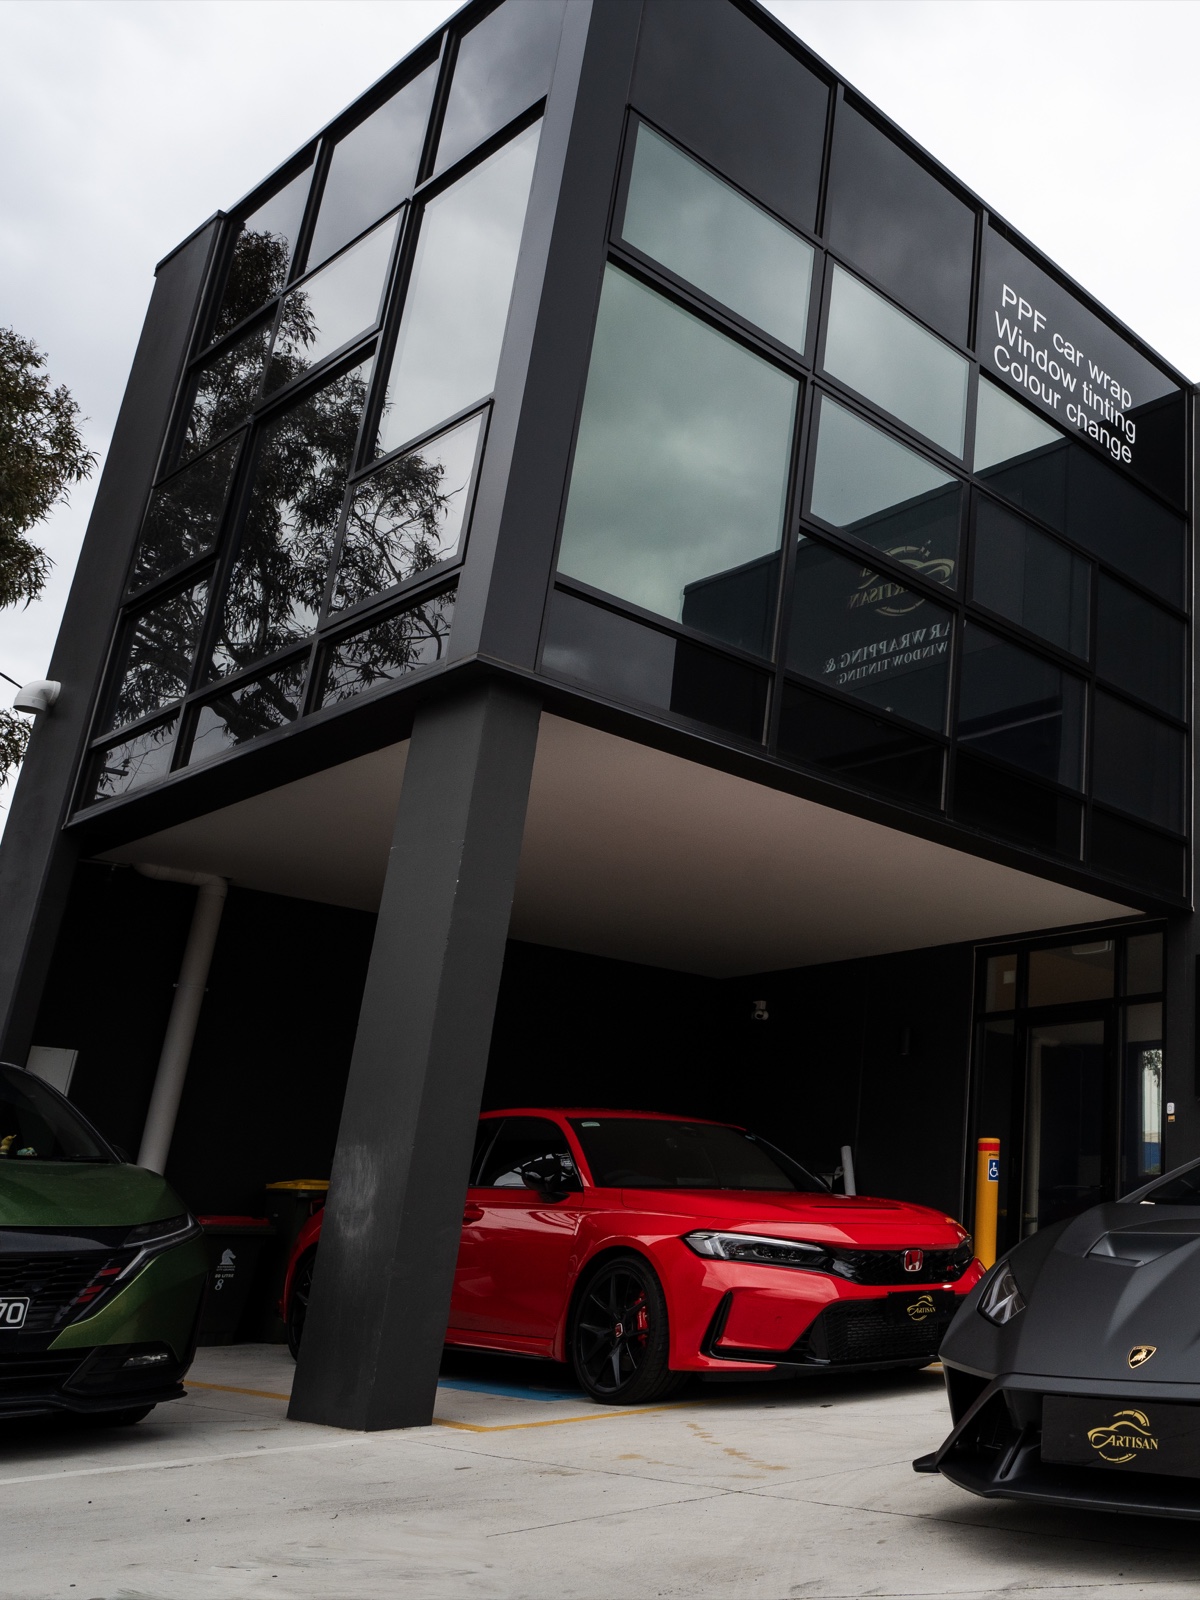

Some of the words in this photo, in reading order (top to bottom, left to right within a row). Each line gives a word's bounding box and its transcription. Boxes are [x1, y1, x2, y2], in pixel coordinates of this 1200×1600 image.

[994, 345, 1062, 409] Colour
[1066, 403, 1132, 464] change
[995, 310, 1077, 392] Window
[1082, 381, 1136, 444] tinting
[1001, 284, 1047, 333] PPF
[1053, 333, 1084, 367] car
[1089, 360, 1132, 409] wrap
[215, 1279, 224, 1290] 8
[1107, 1435, 1159, 1450] ARTISAN
